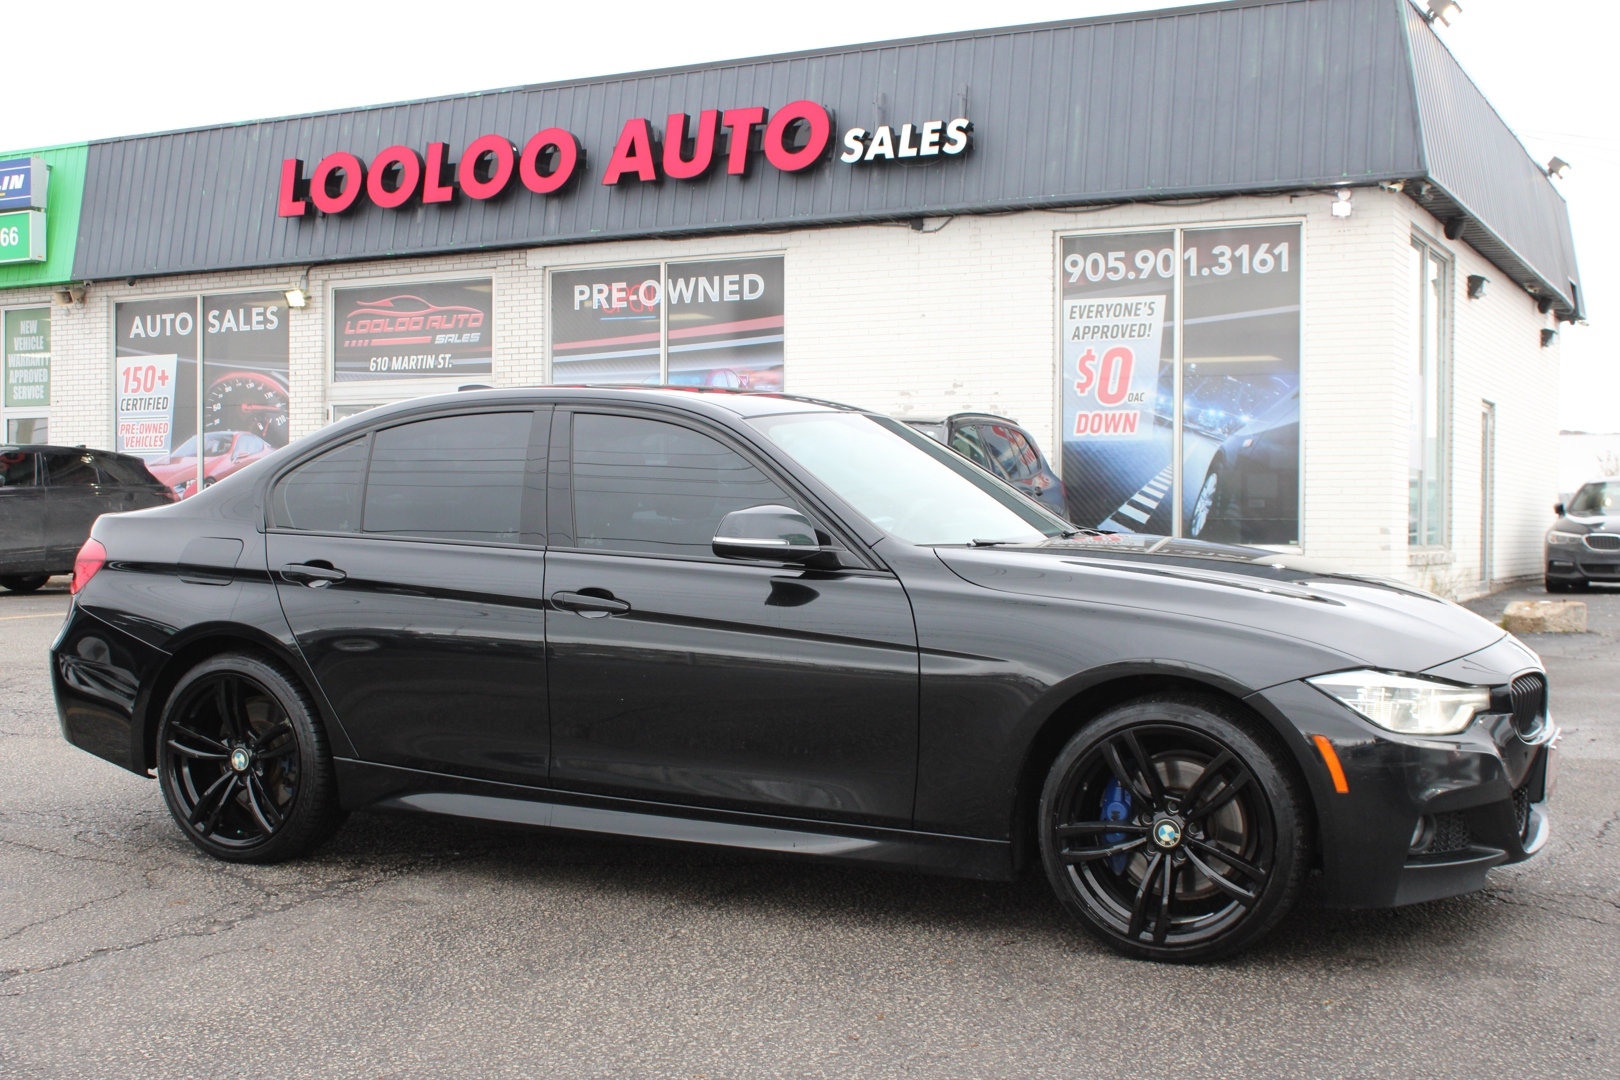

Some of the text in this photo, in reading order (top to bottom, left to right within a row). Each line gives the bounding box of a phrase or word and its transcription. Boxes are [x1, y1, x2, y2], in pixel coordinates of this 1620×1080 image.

[278, 100, 970, 217] LOOLOO AUTO SALES
[0, 174, 25, 191] IN
[1063, 242, 1289, 282] 905.901.3161
[573, 273, 765, 310] PRE-OWNED
[1068, 301, 1156, 320] EVERYONE'S
[20, 320, 38, 334] NEW
[129, 306, 279, 339] AUTO SALES
[344, 313, 485, 335] LOOLOO AUTO
[434, 332, 481, 345] SALES
[1071, 322, 1153, 342] APPROVED!
[14, 335, 44, 351] VEHICLE
[369, 353, 453, 371] 610 MARTIN ST.
[9, 368, 48, 383] APPROVED
[122, 364, 169, 394] 150+
[1075, 346, 1134, 405] $0
[13, 385, 44, 399] SERVICE
[1127, 392, 1145, 403] OAC
[120, 396, 169, 411] CERTIFIED
[119, 422, 169, 435] PRE-OWNED
[1076, 412, 1137, 434] DOWN
[125, 435, 164, 448] VEHICLES
